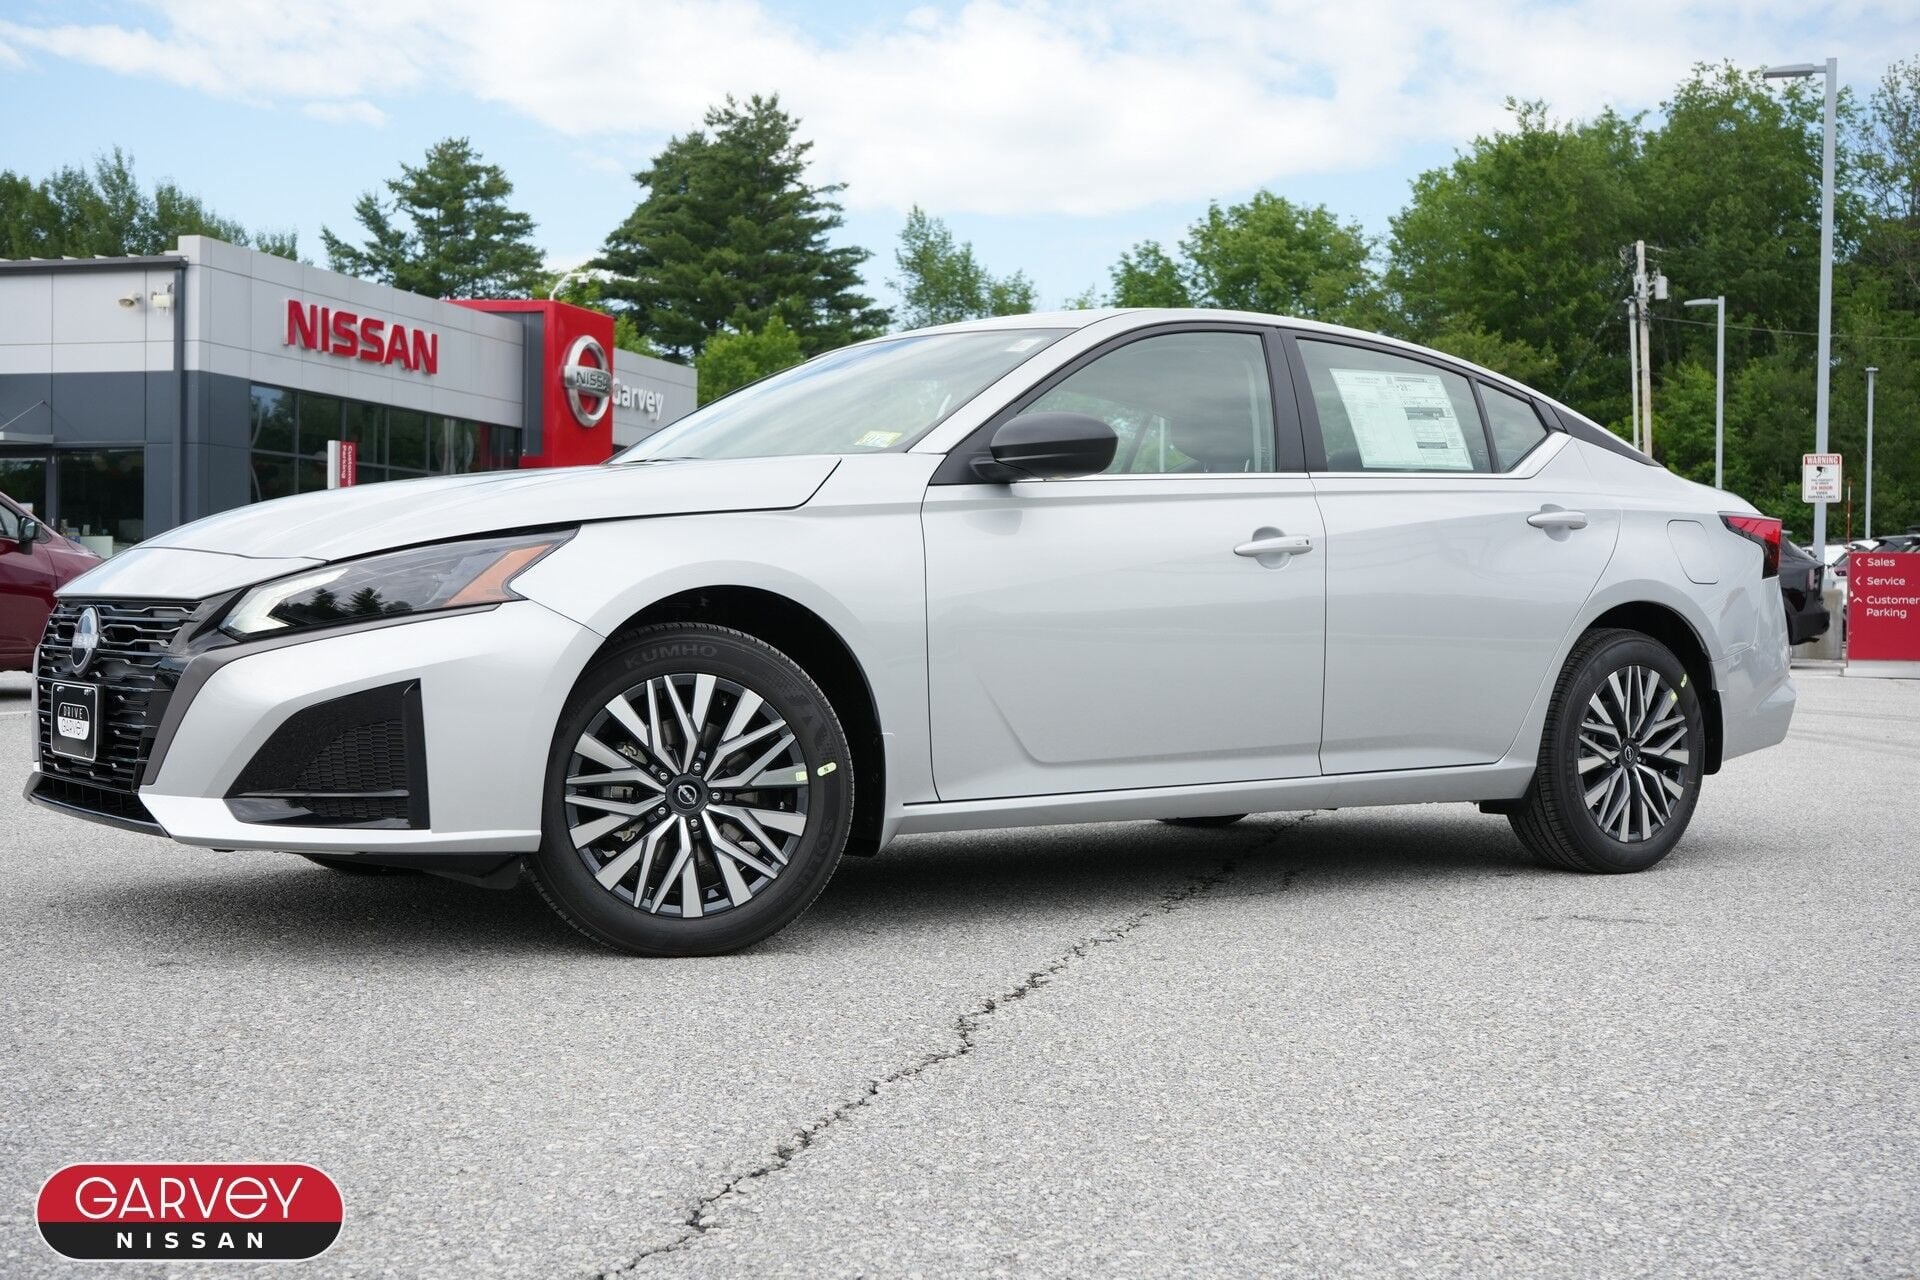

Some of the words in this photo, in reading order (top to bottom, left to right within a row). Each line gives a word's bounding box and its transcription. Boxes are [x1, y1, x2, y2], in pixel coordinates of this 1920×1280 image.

[285, 299, 438, 375] NISSAN
[612, 377, 664, 421] Garvey
[1807, 456, 1838, 465] WARNING
[1867, 557, 1896, 567] Sales
[1866, 576, 1906, 586] Service
[1866, 595, 1920, 605] Customer
[1866, 608, 1907, 619] Parking
[624, 644, 718, 669] KUMHO
[63, 705, 84, 719] DRIVE
